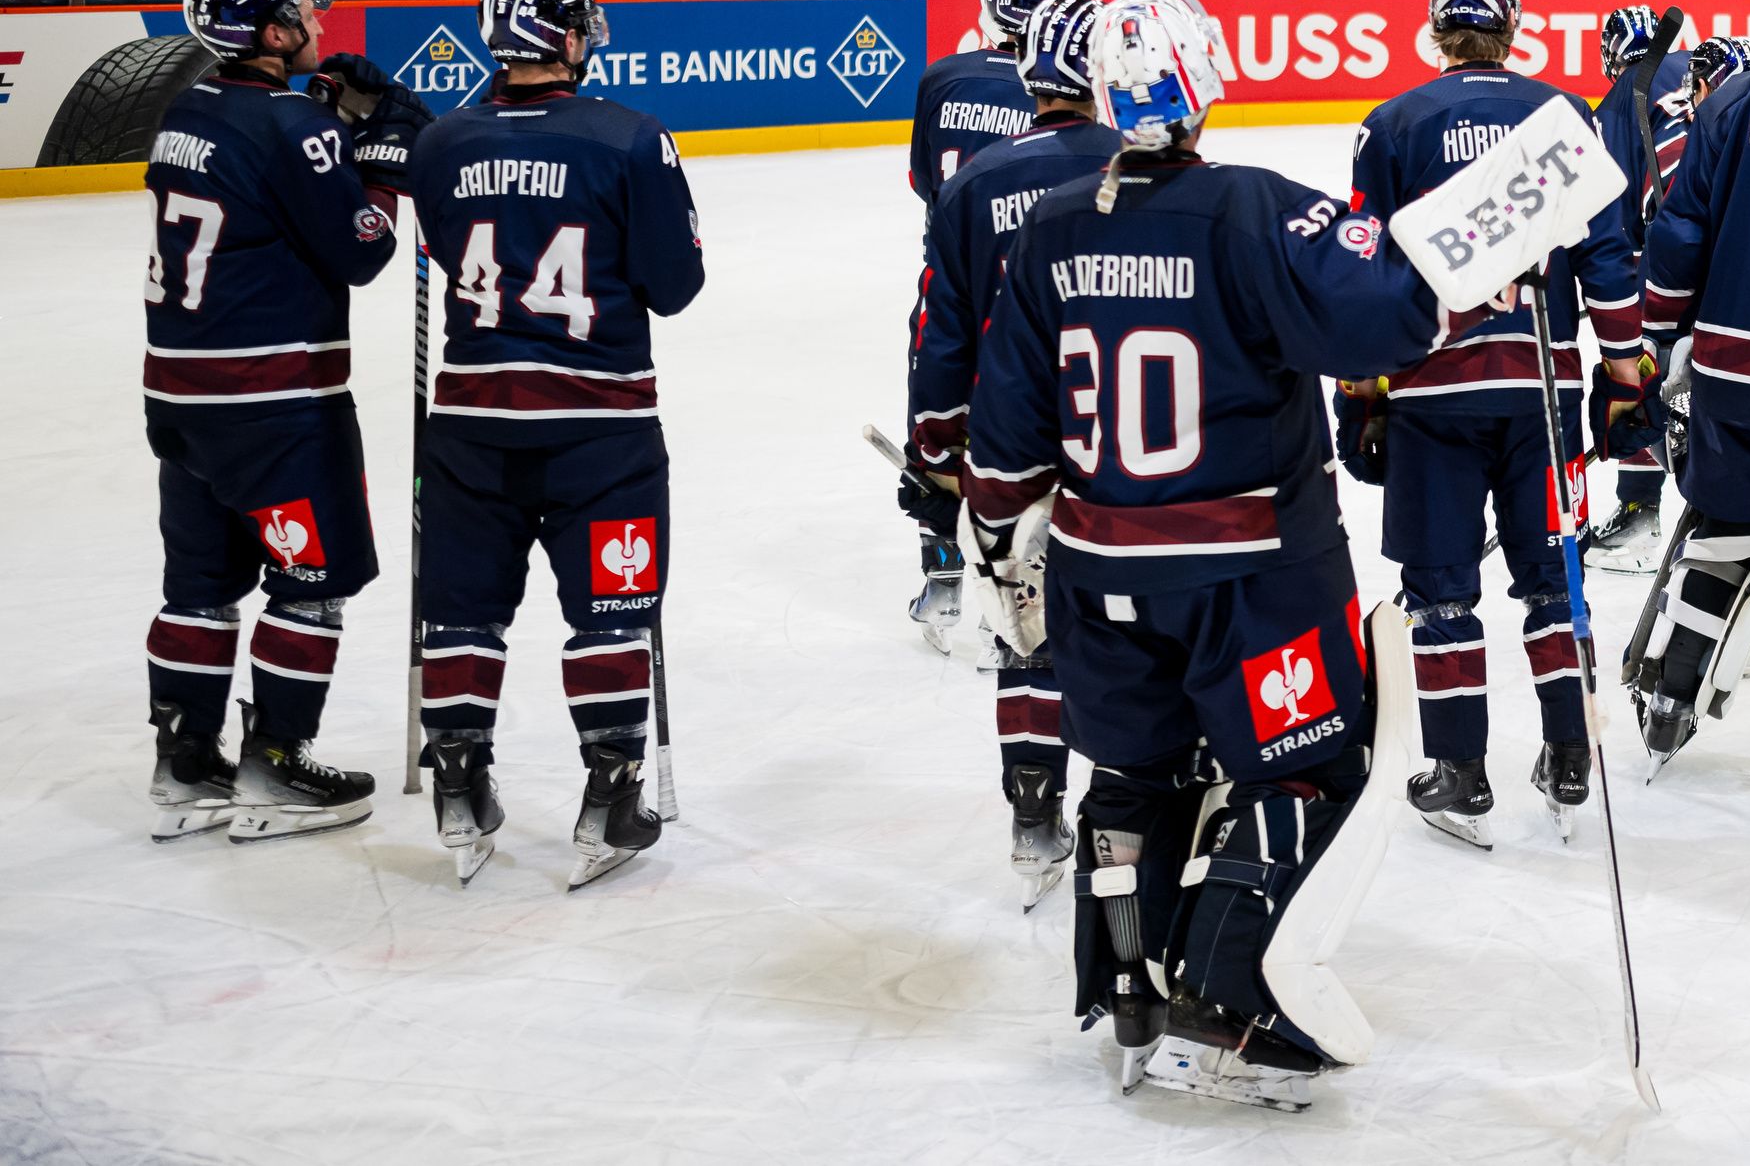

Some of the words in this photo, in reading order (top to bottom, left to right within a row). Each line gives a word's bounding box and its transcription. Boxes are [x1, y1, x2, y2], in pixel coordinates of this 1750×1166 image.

[518, 5, 537, 17] 44
[1439, 6, 1495, 19] STADLER
[581, 52, 648, 86] ATE
[660, 47, 817, 84] BANKING
[841, 49, 893, 78] LGT
[1069, 44, 1080, 56] 5
[1208, 13, 1390, 82] AUSS
[412, 63, 474, 93] LGT
[302, 130, 342, 175] 97
[659, 131, 680, 168] 4
[1443, 120, 1523, 163] HÖRD
[456, 222, 597, 342] 44
[1058, 328, 1202, 477] 30
[1260, 716, 1345, 763] STRAUSS
